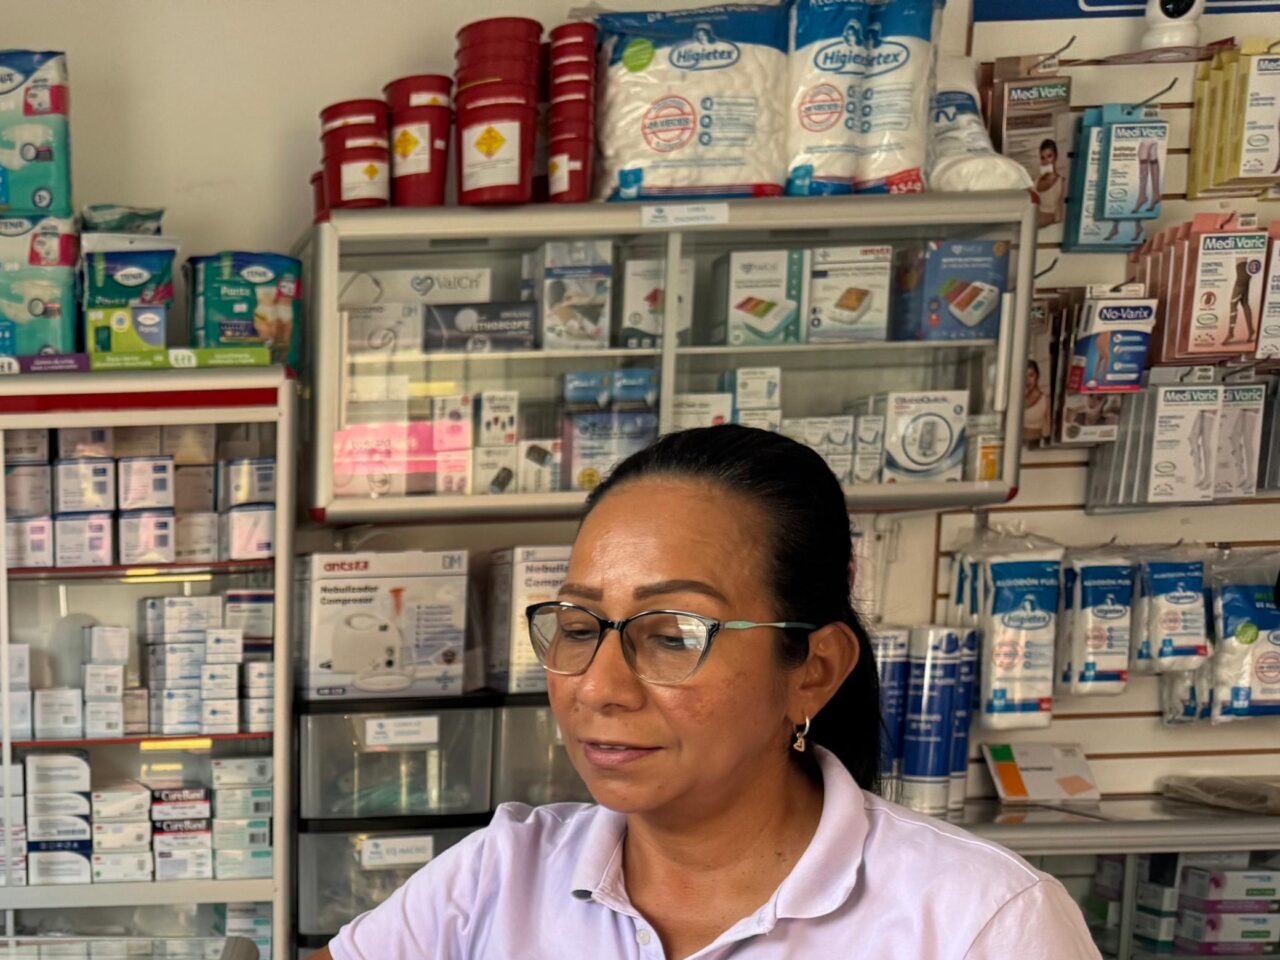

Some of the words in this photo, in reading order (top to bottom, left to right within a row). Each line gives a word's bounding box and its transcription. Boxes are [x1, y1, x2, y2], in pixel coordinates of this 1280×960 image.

[677, 47, 735, 64] Higietex
[1204, 237, 1235, 249] Medi
[1236, 235, 1264, 248] Varic
[1101, 308, 1150, 319] No-Varix
